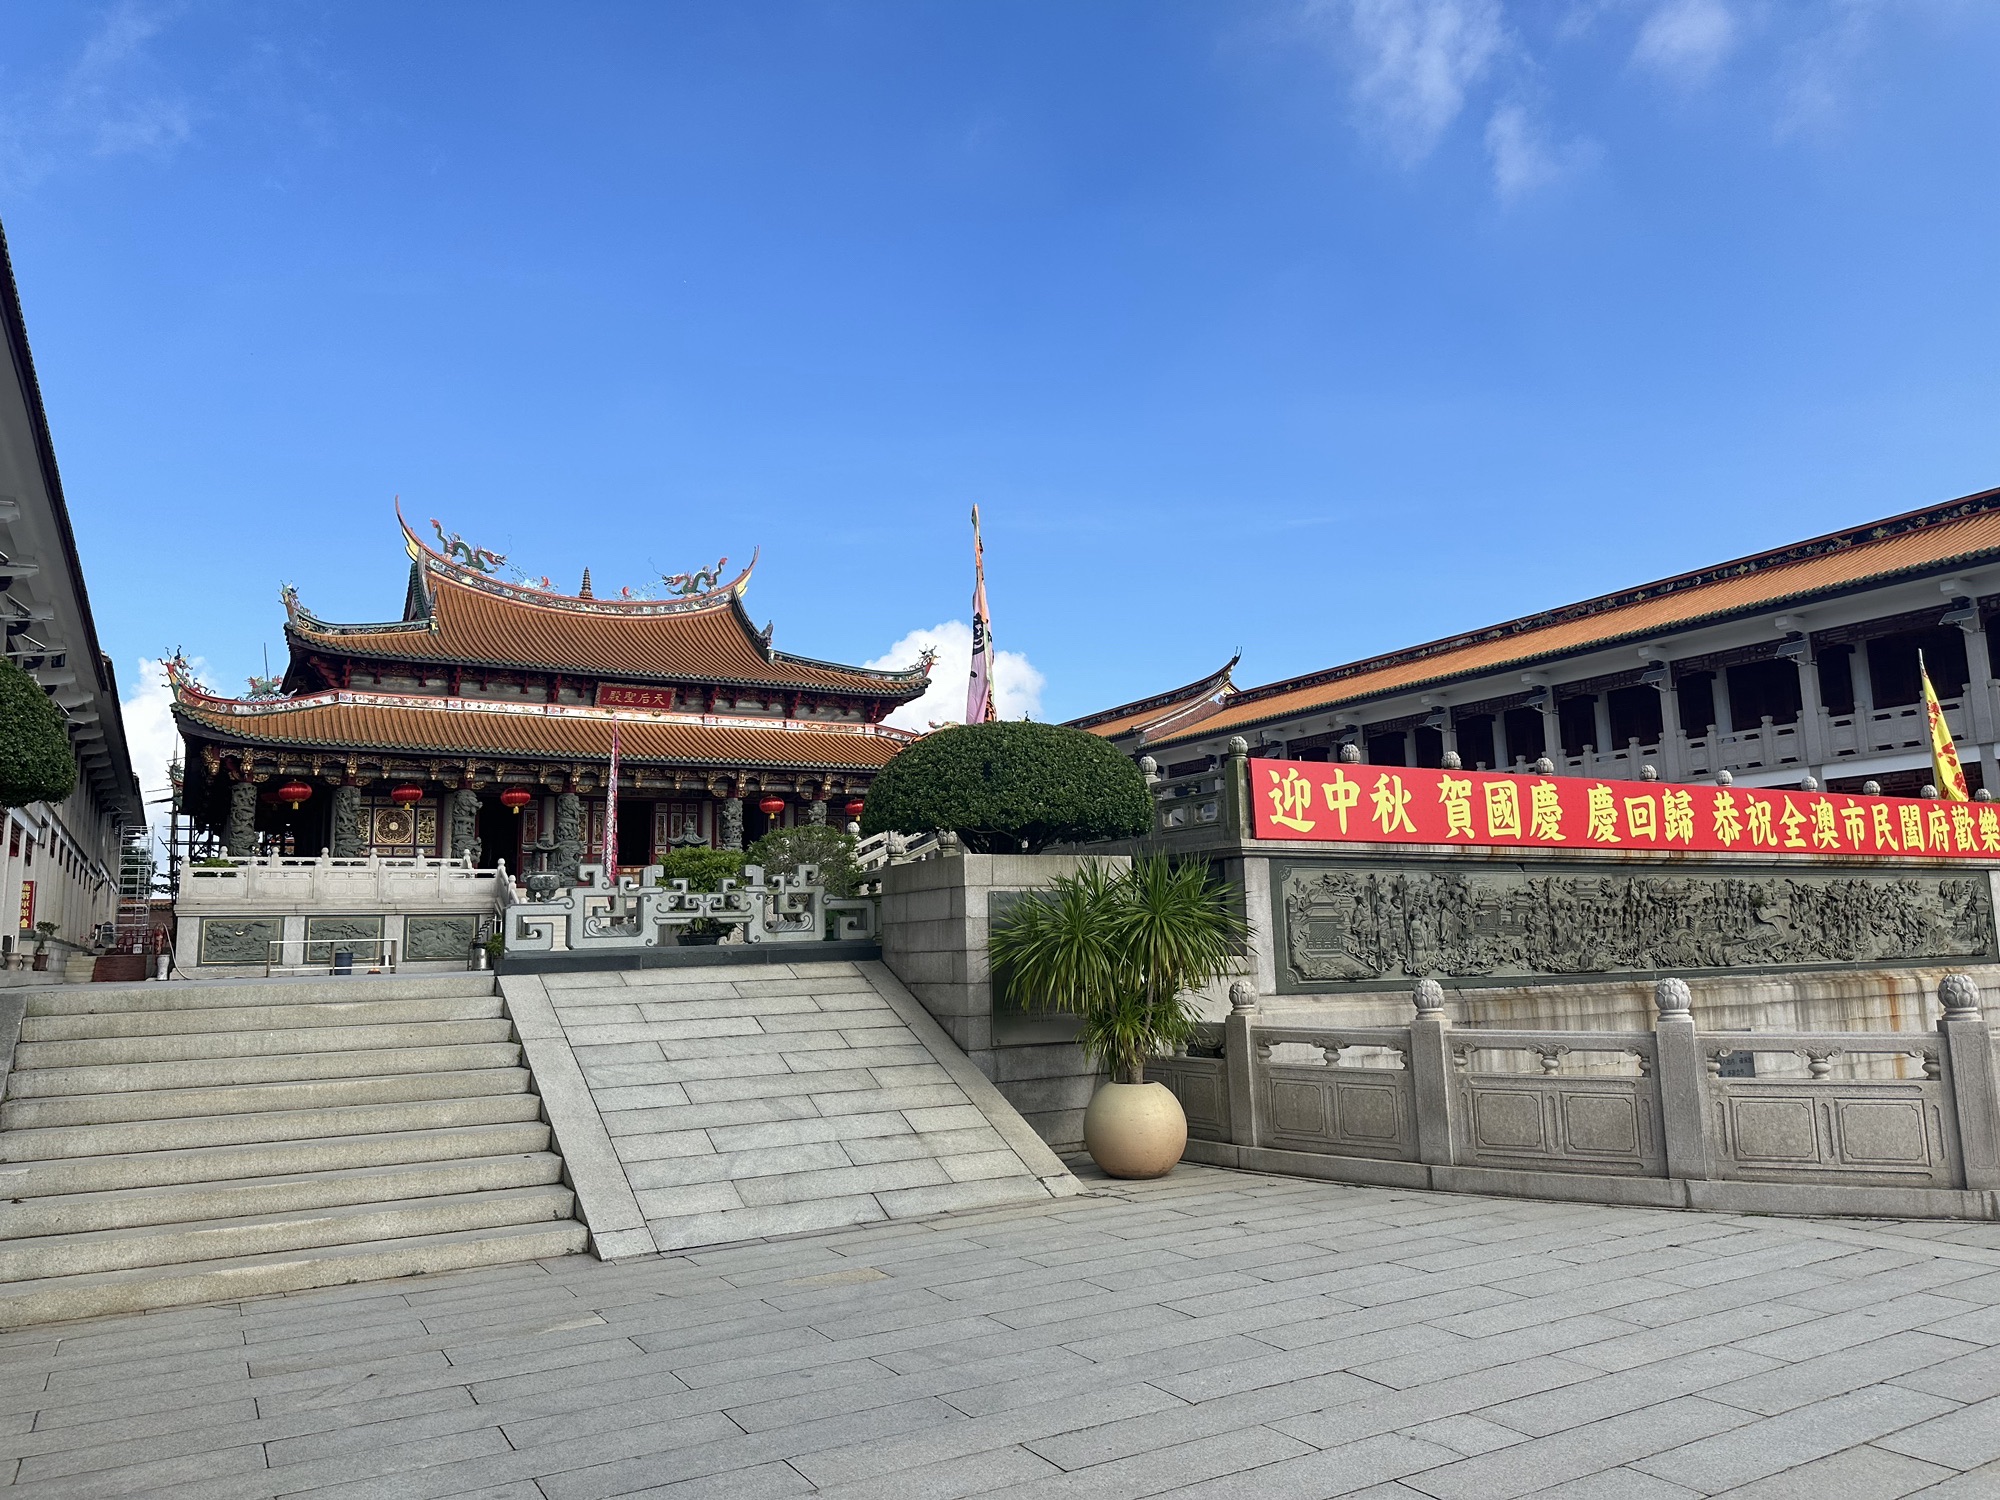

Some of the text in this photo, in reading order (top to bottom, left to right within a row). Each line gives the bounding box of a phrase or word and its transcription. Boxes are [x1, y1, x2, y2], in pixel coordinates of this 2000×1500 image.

[1267, 766, 1417, 836] 迎中秋
[1437, 774, 1566, 841] 賀國慶
[1586, 782, 1695, 845] 慶回歸
